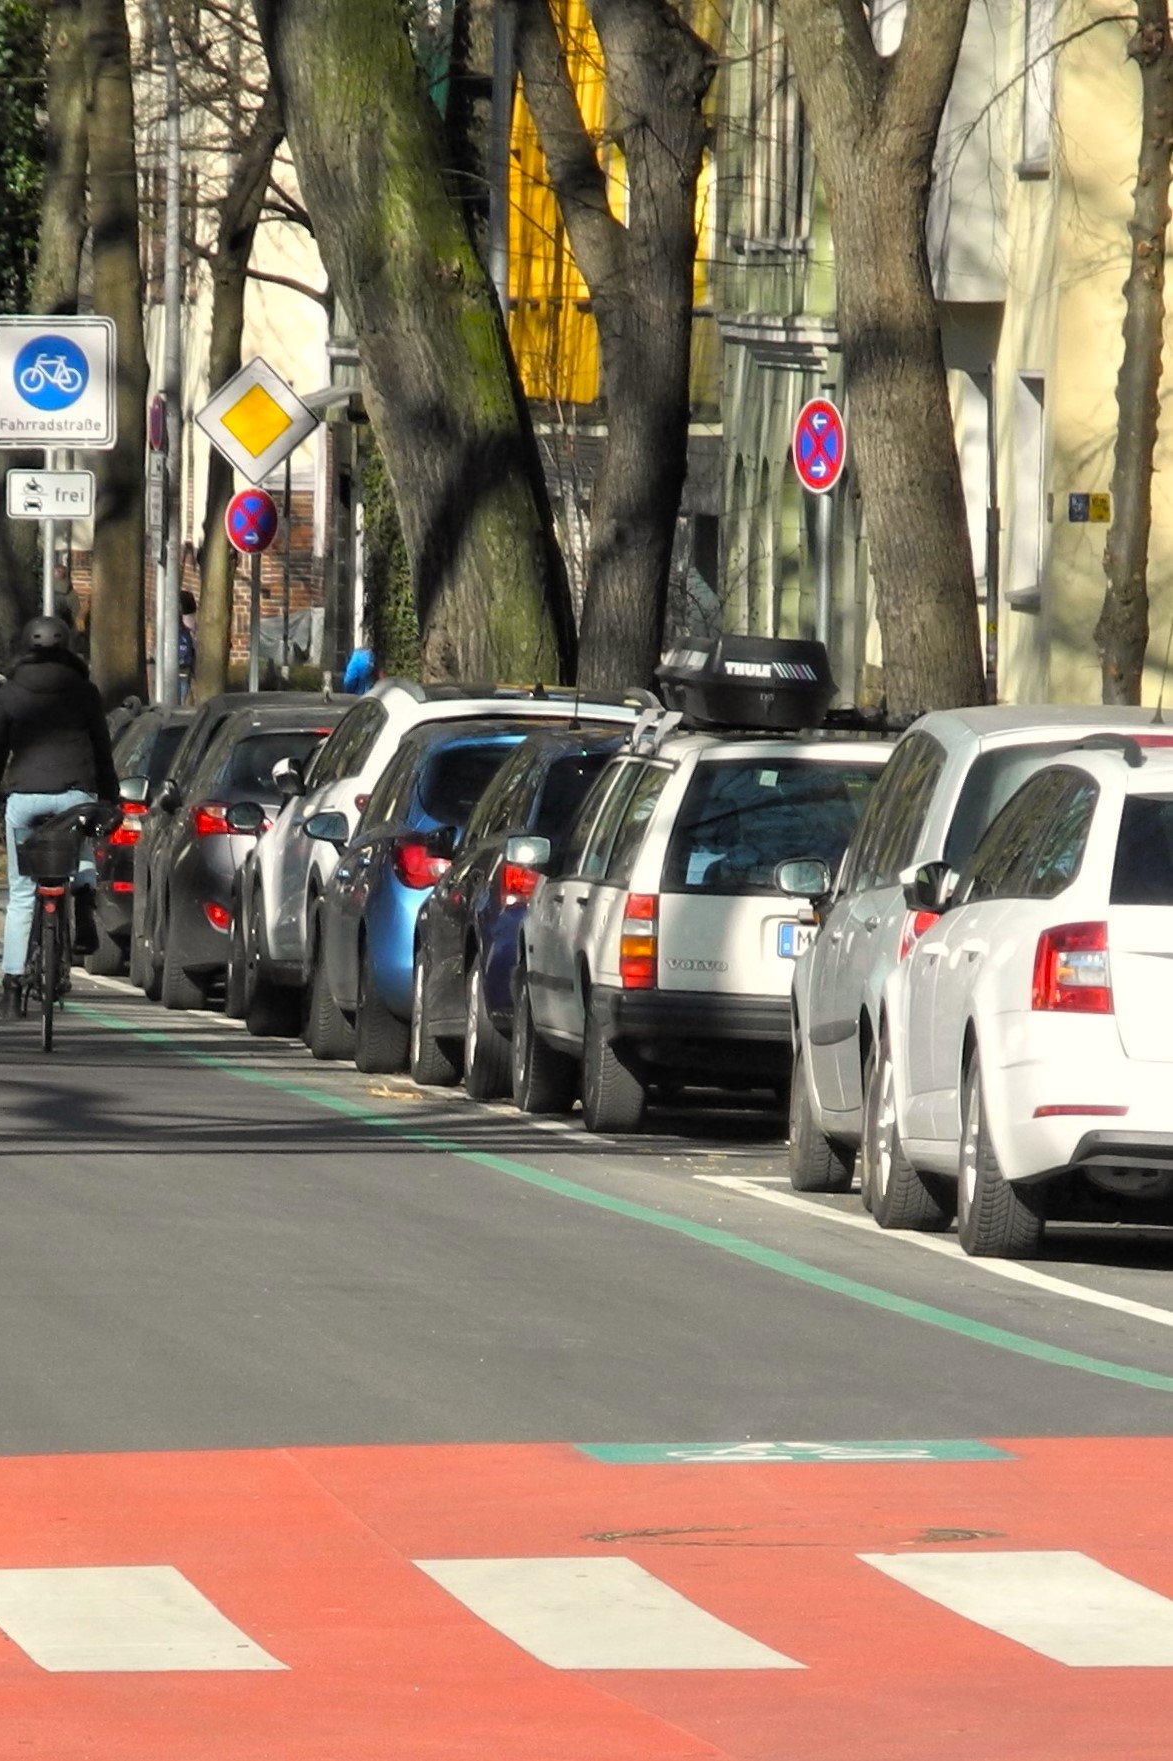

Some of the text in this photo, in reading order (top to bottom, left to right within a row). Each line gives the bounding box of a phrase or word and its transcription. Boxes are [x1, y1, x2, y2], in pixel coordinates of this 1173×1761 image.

[0, 418, 102, 432] Fahrradstraße
[55, 487, 85, 503] frei
[725, 661, 772, 678] THULE
[665, 958, 729, 972] VOLVO
